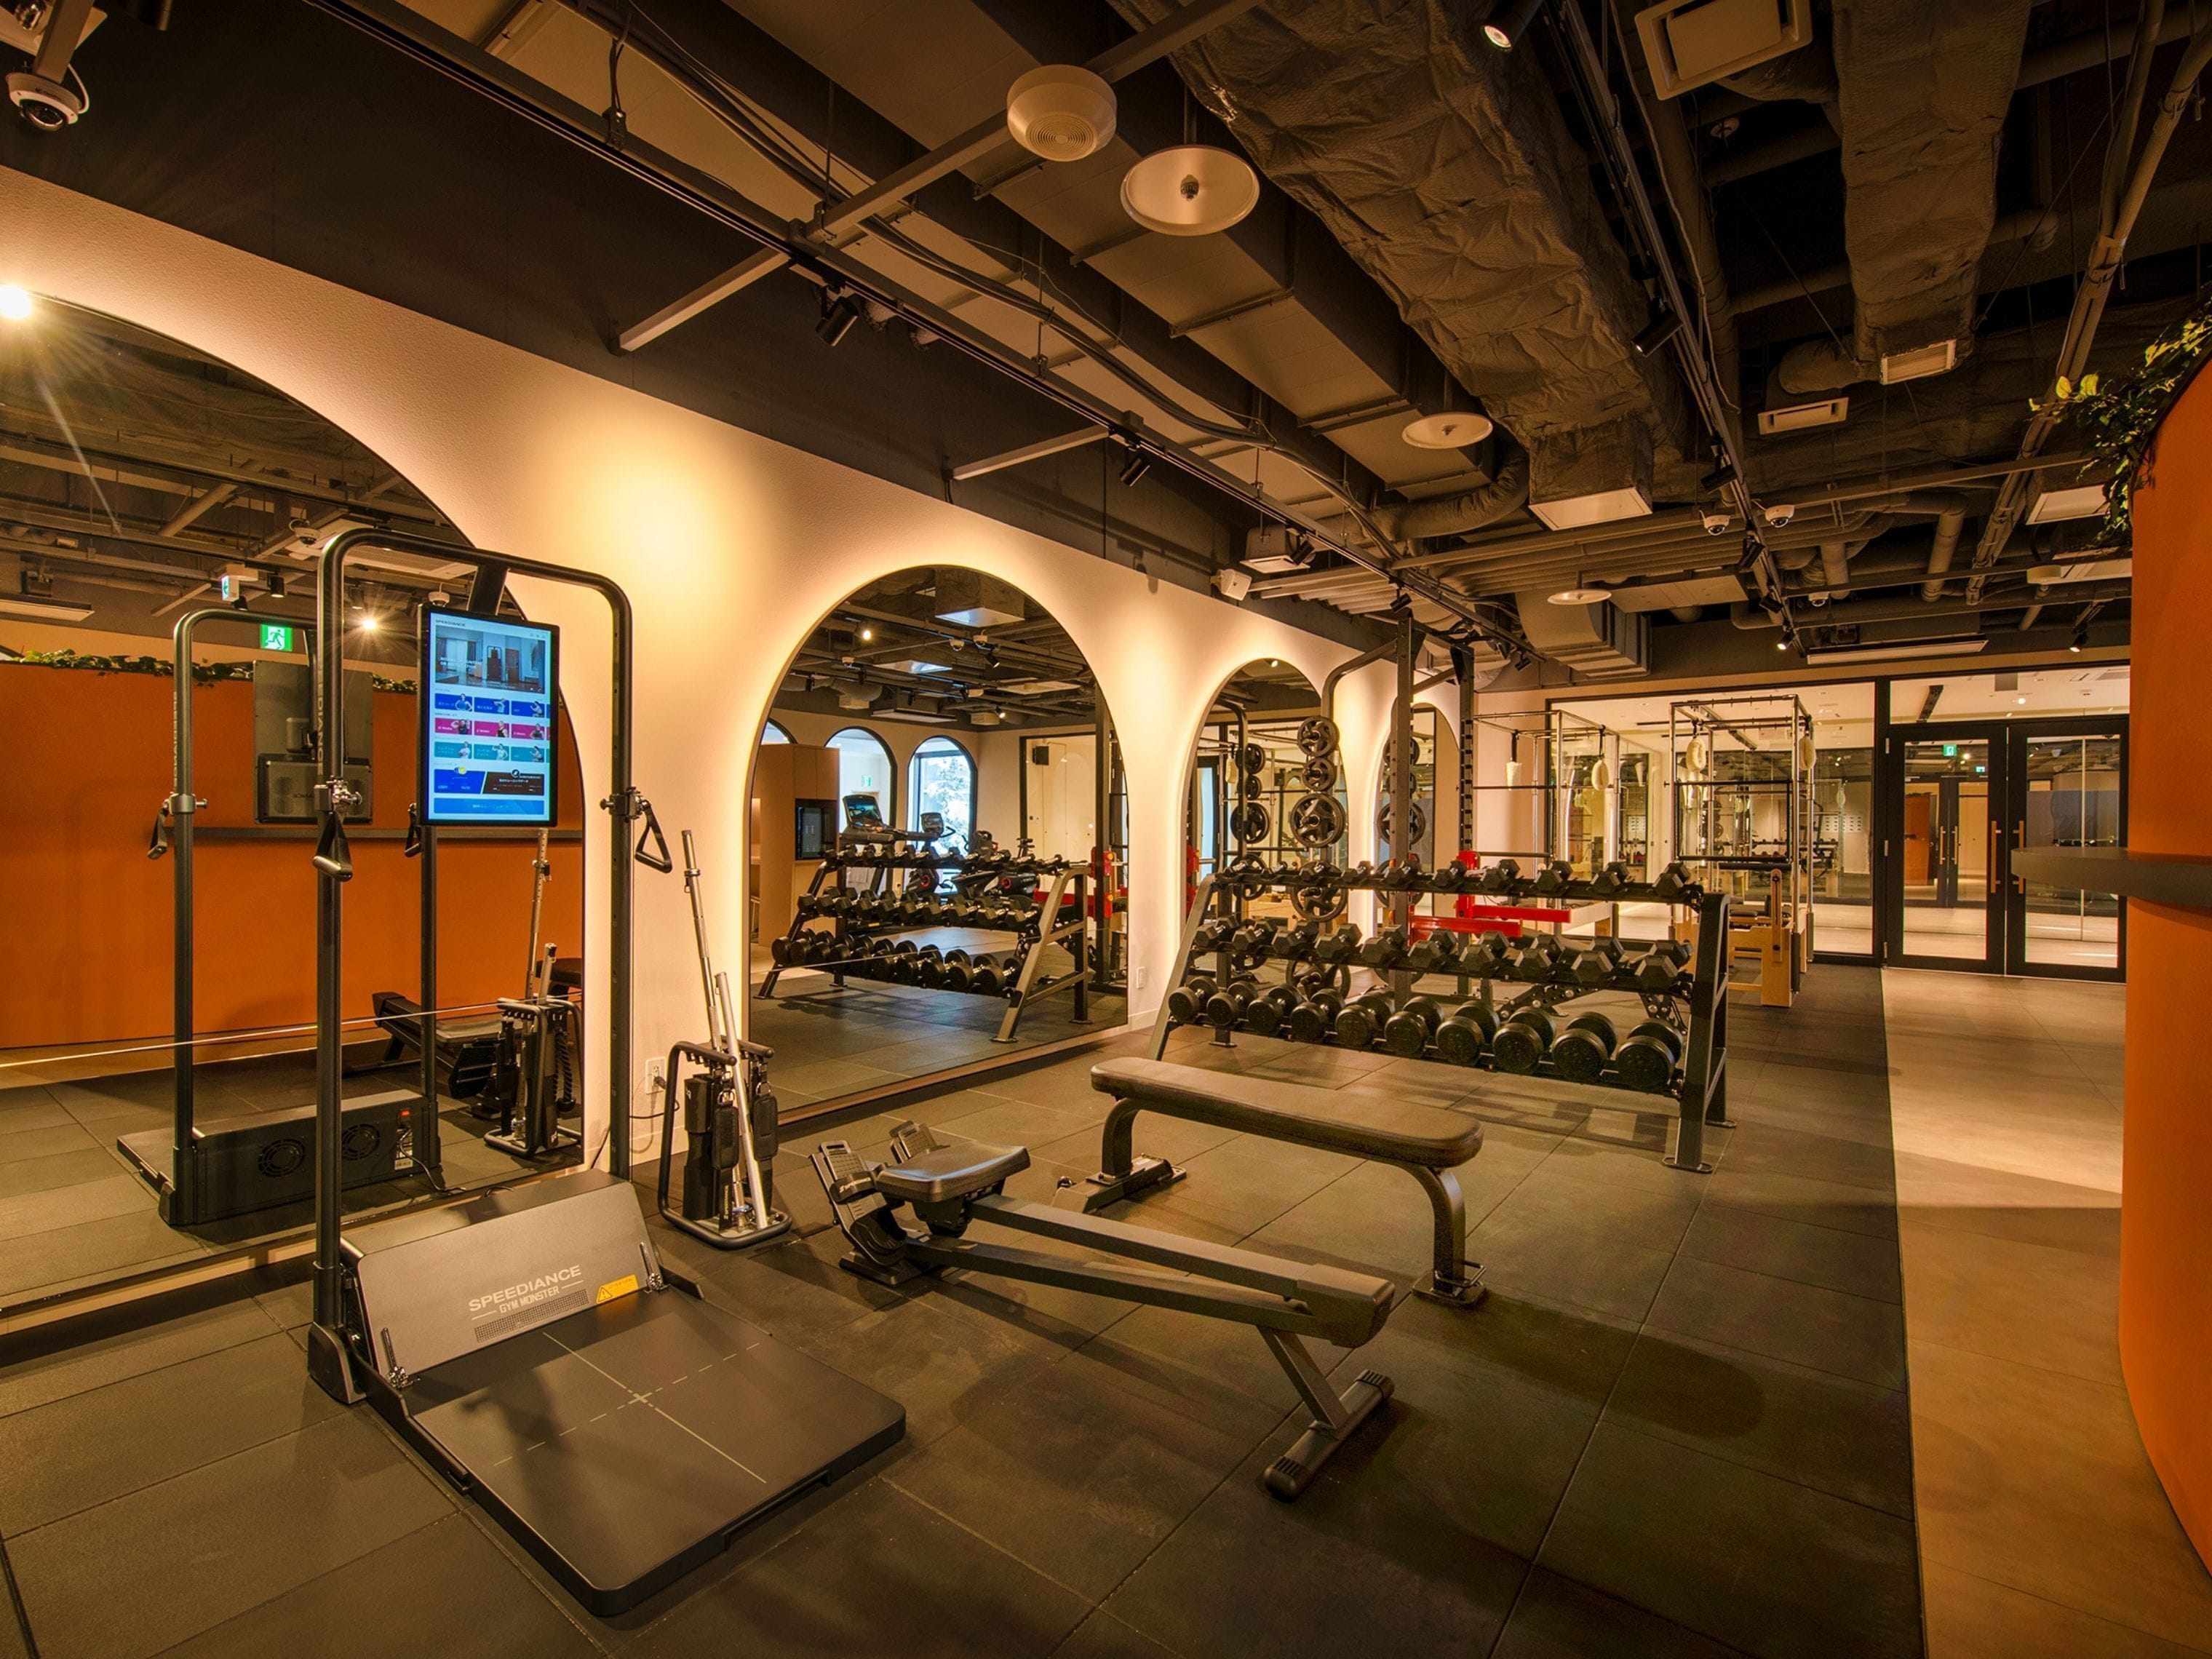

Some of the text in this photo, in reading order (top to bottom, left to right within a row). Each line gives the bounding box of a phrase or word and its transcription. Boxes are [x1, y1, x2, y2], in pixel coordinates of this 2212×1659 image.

[469, 1265, 582, 1311] SPEEDIANCE
[499, 1286, 560, 1314] GYM MONSTER
